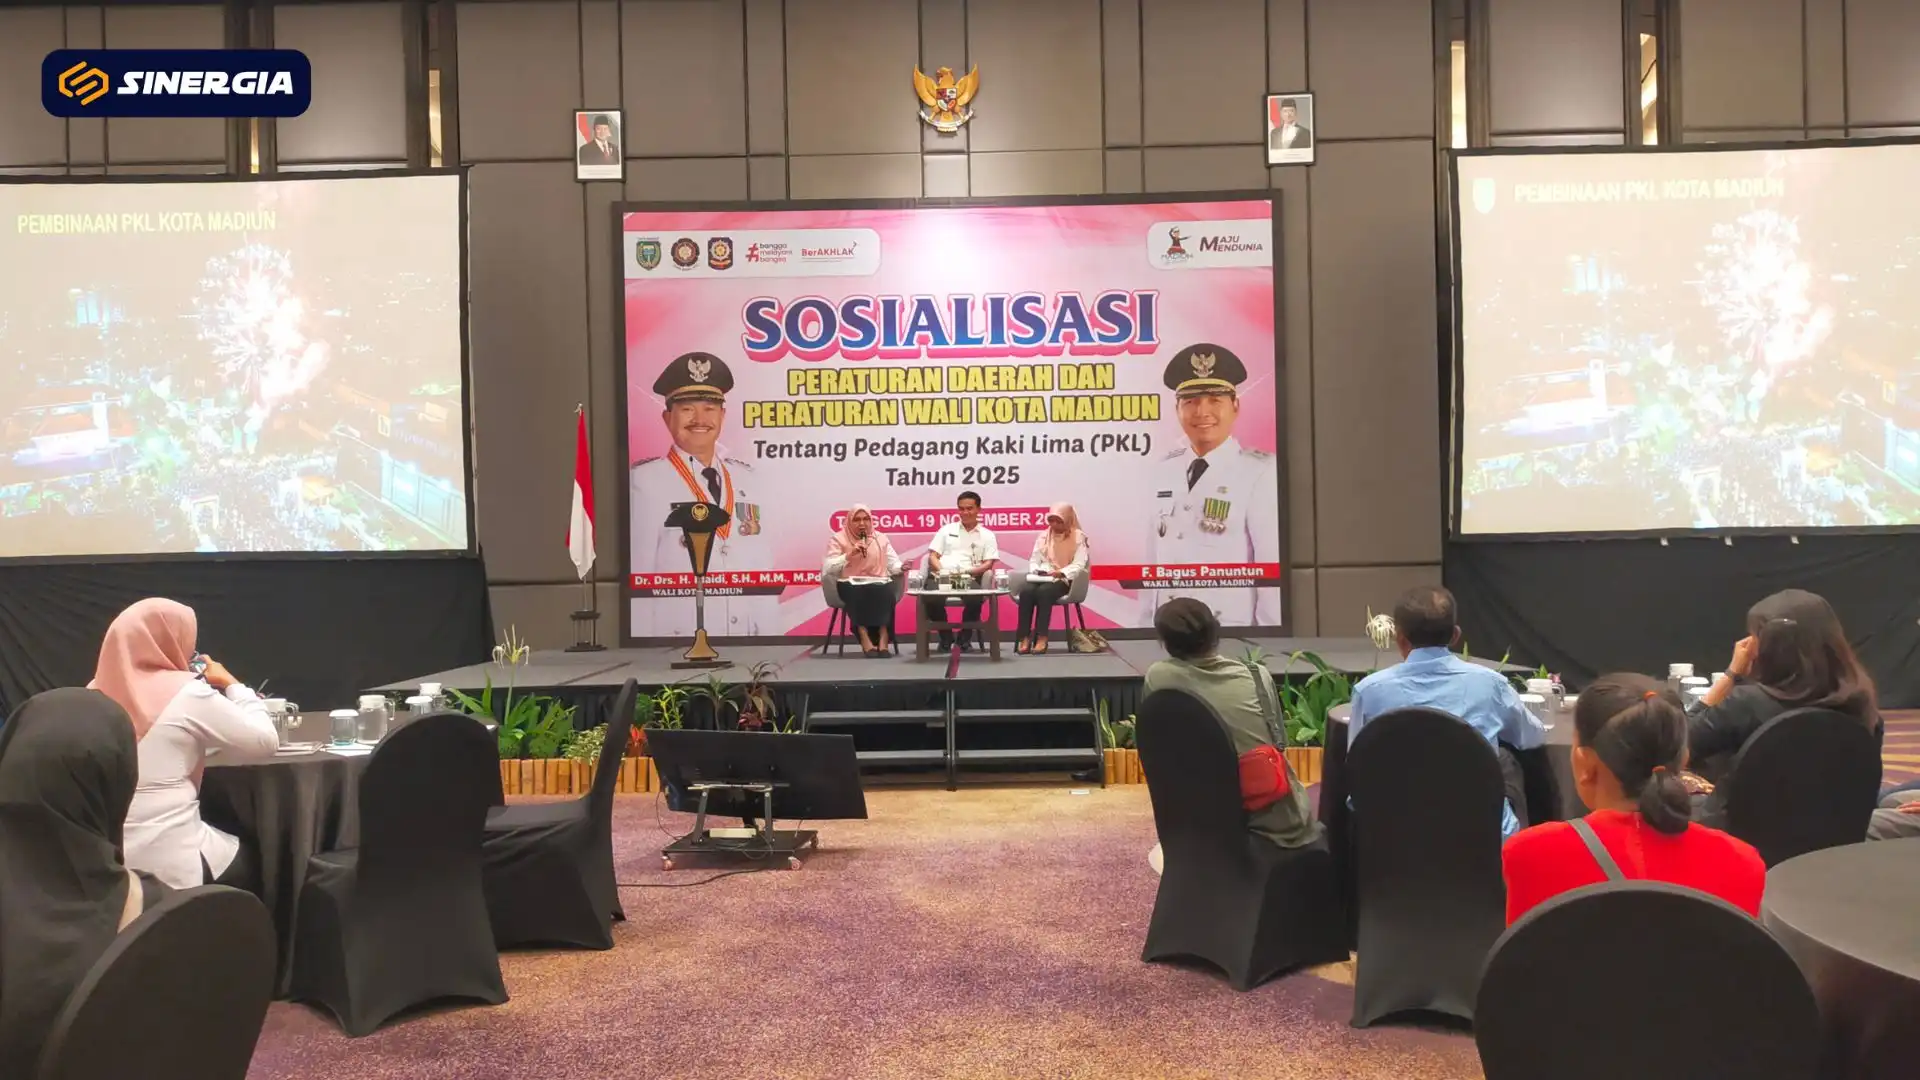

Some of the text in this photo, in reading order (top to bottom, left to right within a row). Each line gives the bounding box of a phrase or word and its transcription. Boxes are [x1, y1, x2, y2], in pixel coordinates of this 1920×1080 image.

[18, 210, 276, 234] PEMBINAAN PKL KOTA MADIUN
[801, 247, 854, 257] BerAKHLAK
[743, 292, 1160, 358] SOSIALISASI
[787, 363, 1115, 395] PERATURAN DAERAH DAN
[743, 394, 1160, 427] PERATURAN WALI KOTA MADIUN
[753, 432, 1151, 461] Tentang Pedagang Kaki Lima (PKL)
[885, 465, 1020, 486] Tahun 2025
[835, 514, 914, 529] TGGAL
[918, 513, 936, 527] 19
[940, 512, 1031, 528] NOEMBER
[635, 575, 651, 586] Dr.
[654, 575, 676, 585] Drs.
[679, 574, 691, 585] H.
[1141, 565, 1264, 580] F. Bagus Panuntun
[652, 588, 676, 597] WALI
[704, 587, 743, 596] MADIUN
[1142, 579, 1255, 588] WAKIL WALI KOTA MADIUN
